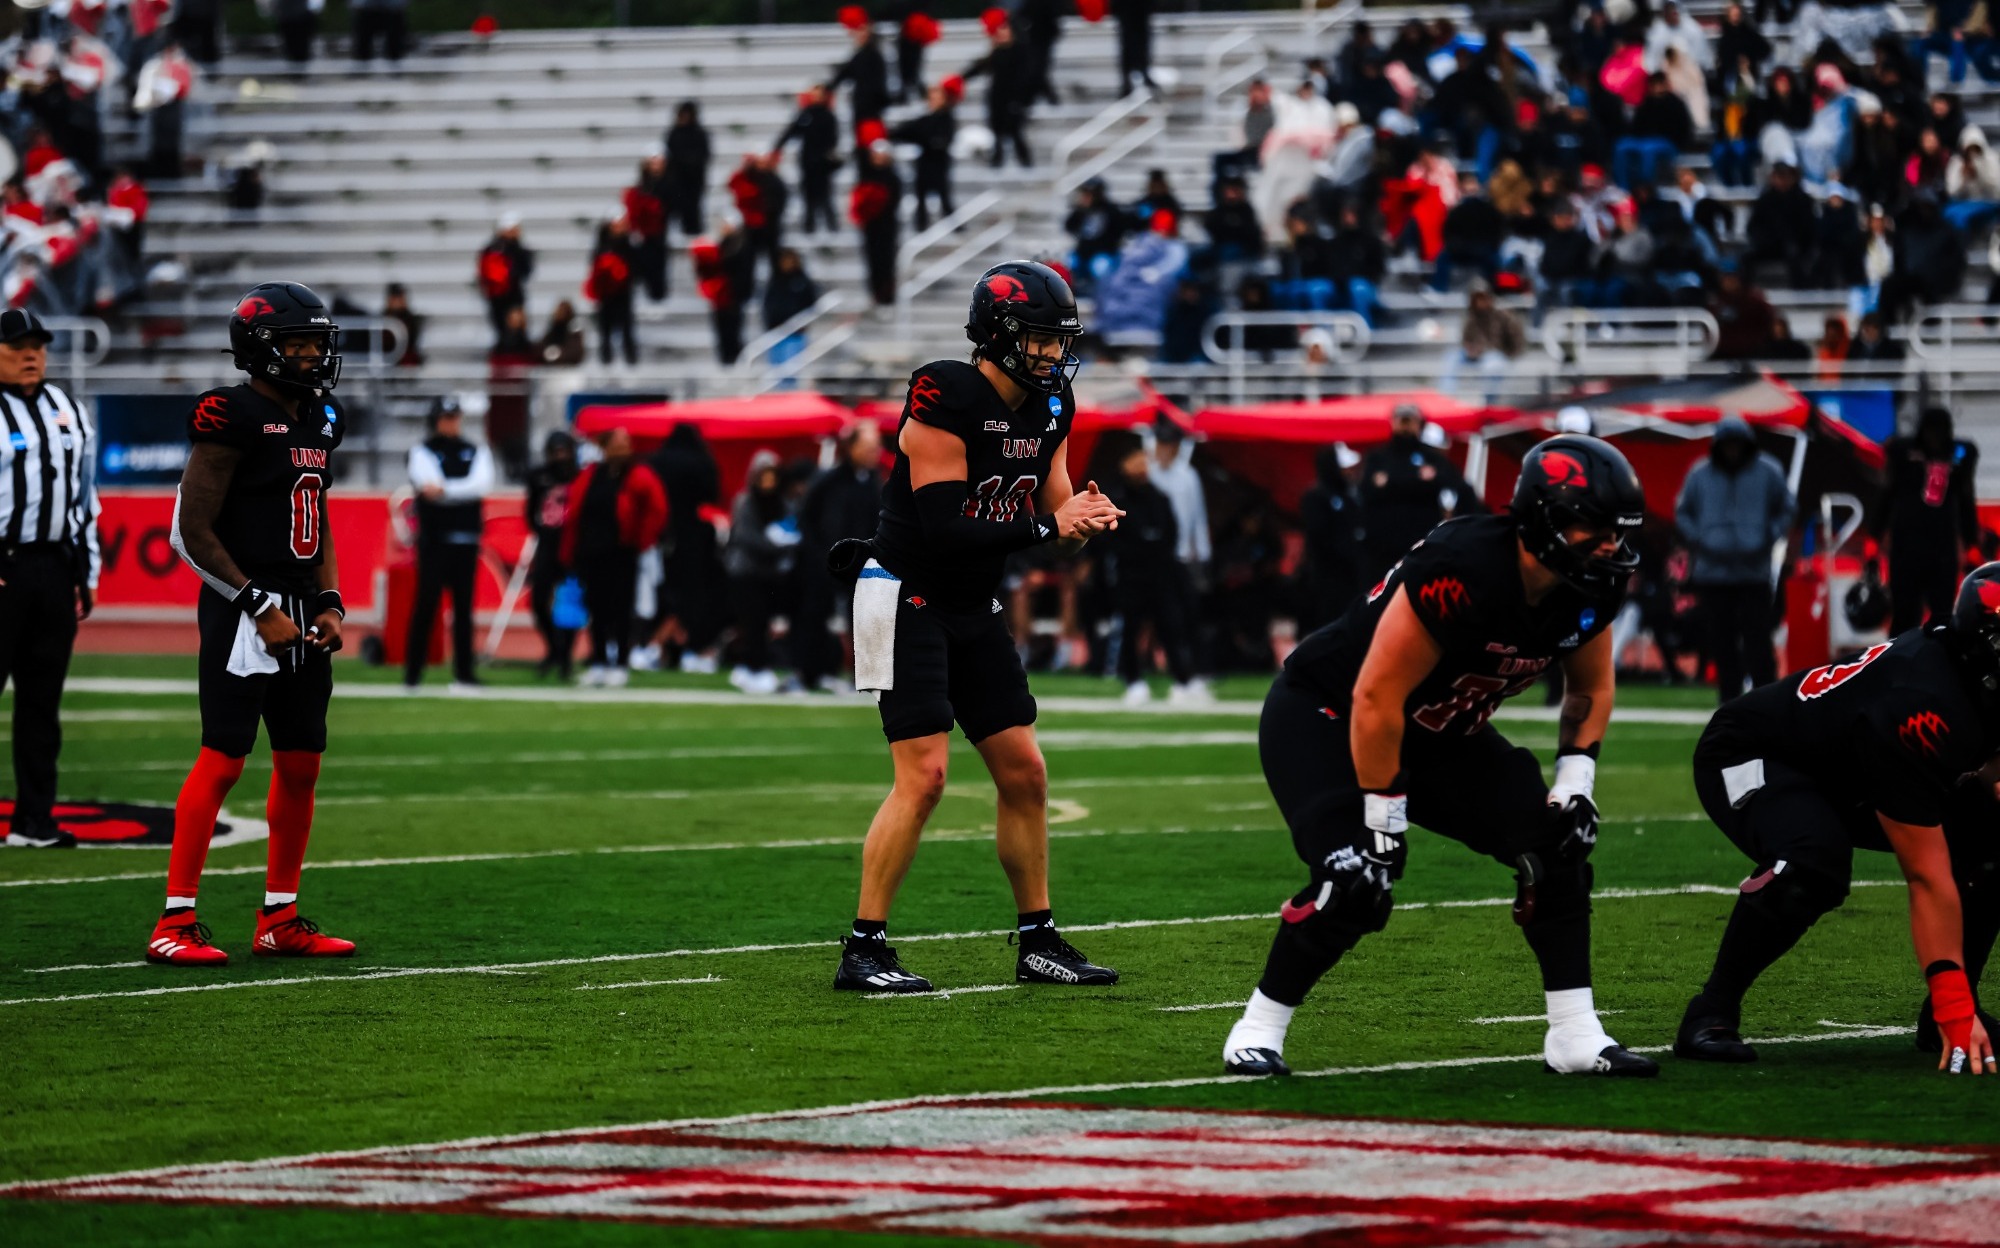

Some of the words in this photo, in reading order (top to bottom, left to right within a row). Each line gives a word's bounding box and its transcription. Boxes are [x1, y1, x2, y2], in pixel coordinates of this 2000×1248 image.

[263, 423, 289, 434] SLC
[983, 420, 1010, 432] SLC
[289, 447, 328, 469] UIW
[1002, 437, 1042, 459] UIW
[290, 473, 324, 559] 0
